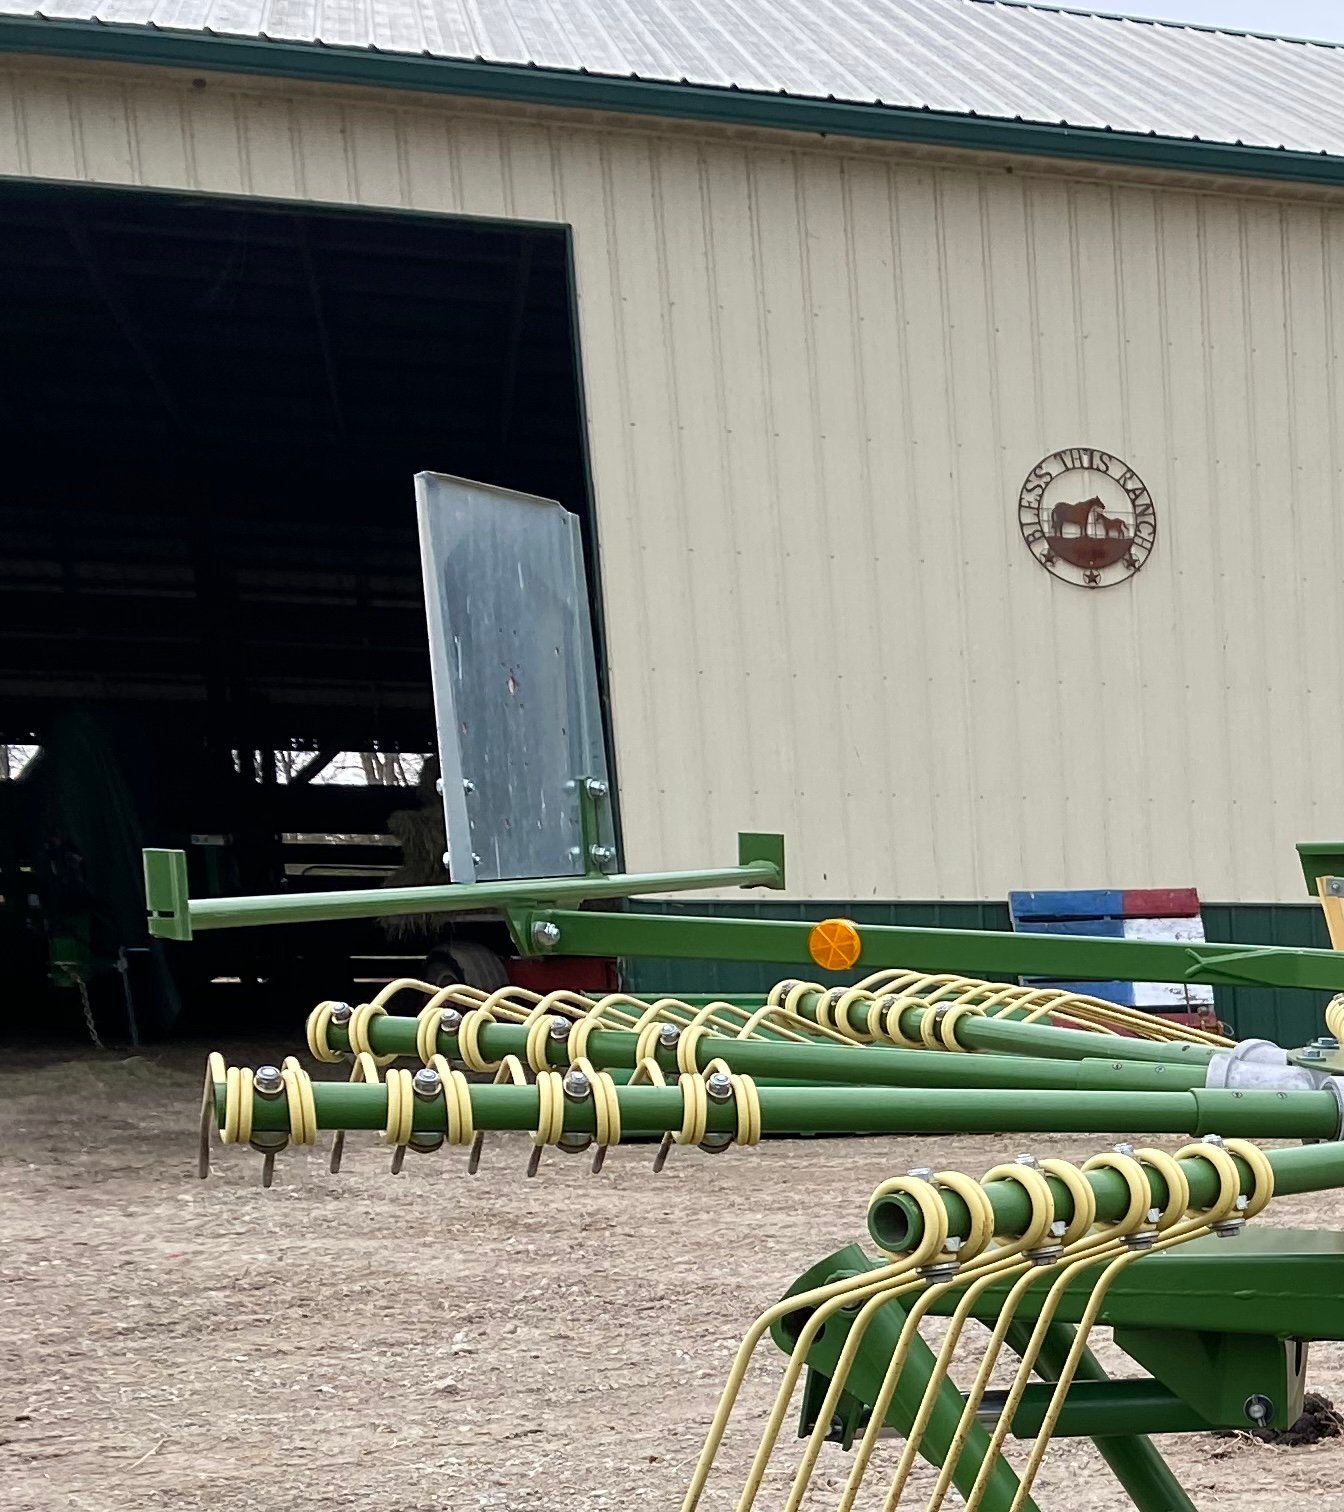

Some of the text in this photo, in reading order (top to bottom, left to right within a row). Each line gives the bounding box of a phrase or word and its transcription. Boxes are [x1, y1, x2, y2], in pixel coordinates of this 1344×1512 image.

[1020, 449, 1155, 554] BLESS THIS RANCH
